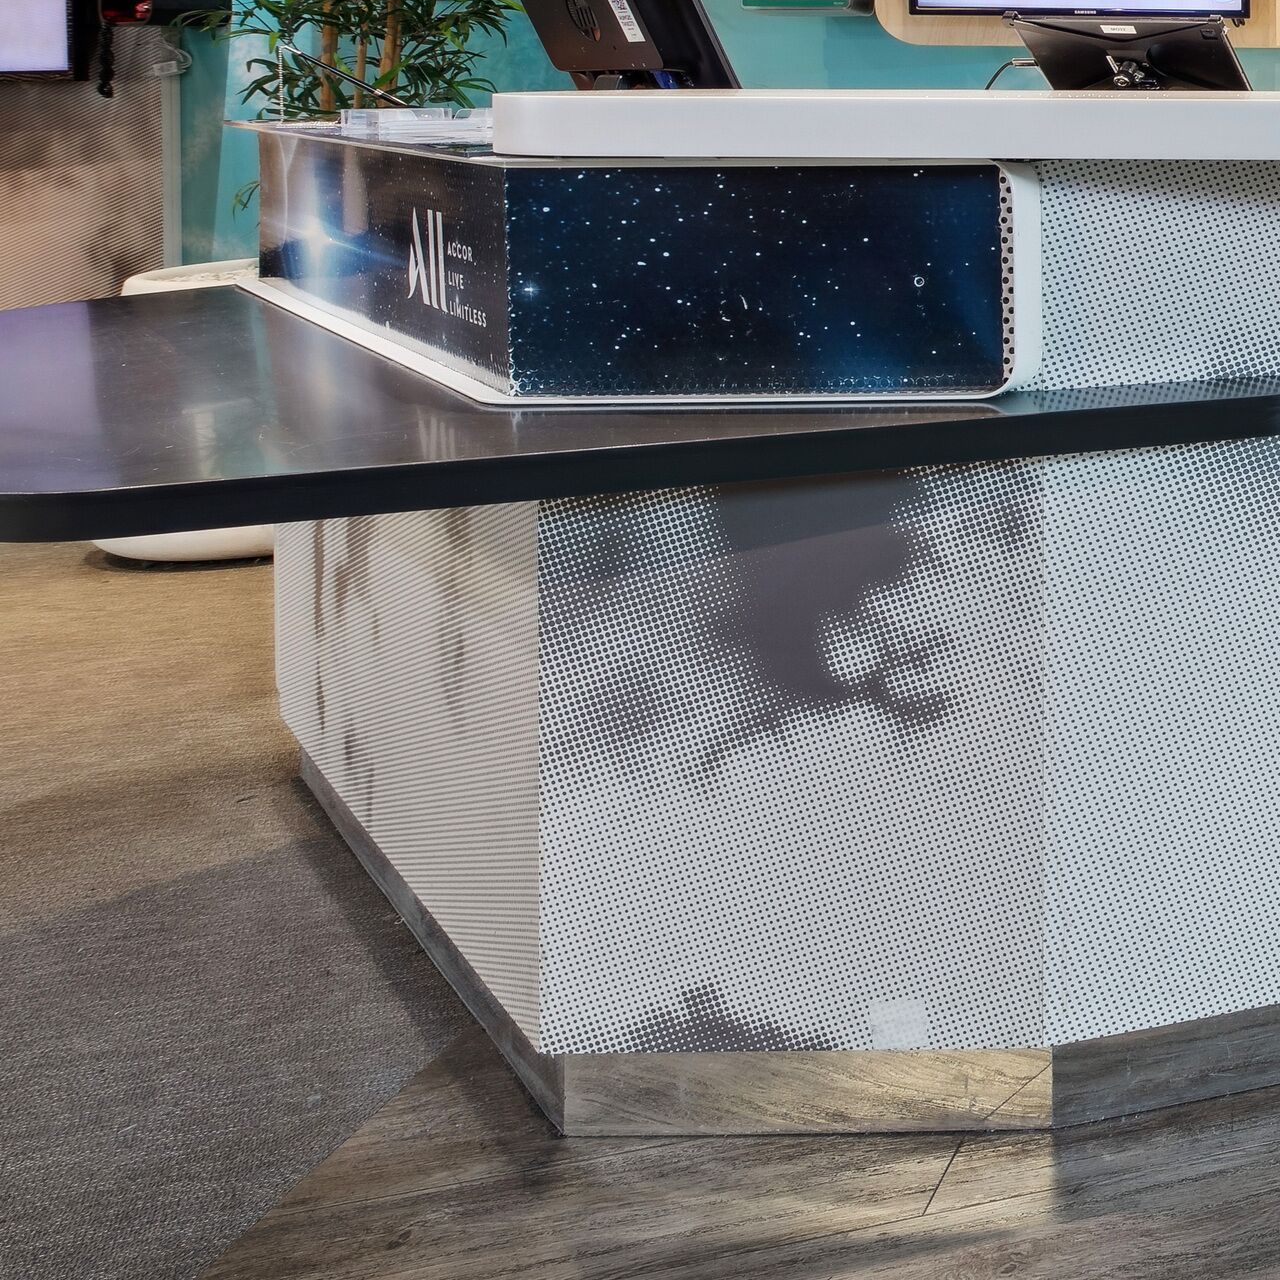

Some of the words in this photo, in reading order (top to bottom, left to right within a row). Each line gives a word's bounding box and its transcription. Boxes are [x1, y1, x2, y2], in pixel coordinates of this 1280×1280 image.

[448, 241, 473, 262] ACCOR
[448, 271, 464, 289] LIVE
[449, 301, 487, 327] LIMITLESS
